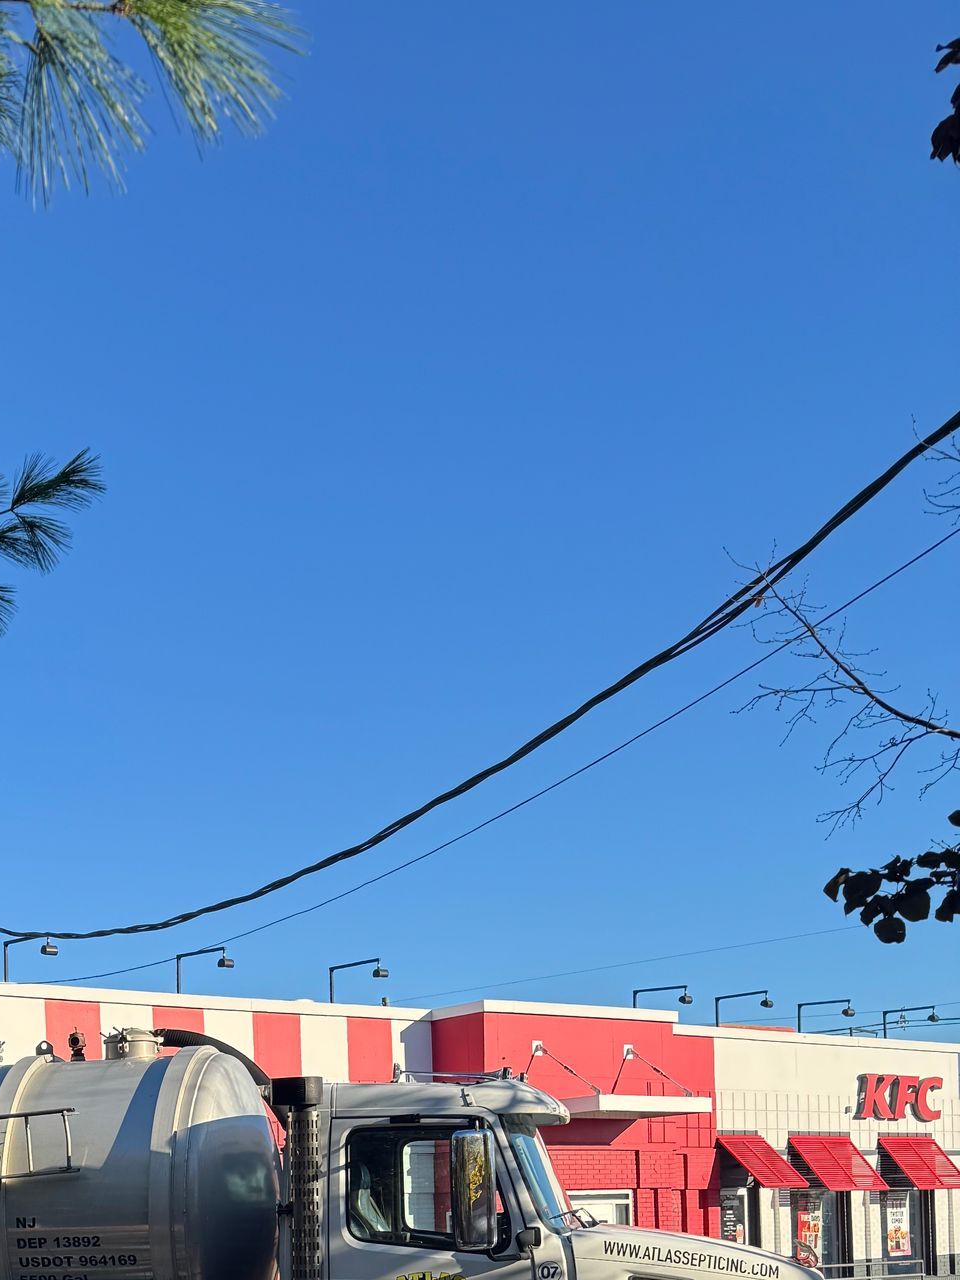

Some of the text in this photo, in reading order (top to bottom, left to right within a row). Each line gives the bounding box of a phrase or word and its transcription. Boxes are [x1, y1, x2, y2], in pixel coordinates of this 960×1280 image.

[854, 1073, 943, 1122] KFC
[16, 1217, 36, 1229] NJ
[16, 1236, 101, 1249] DEP 13892
[19, 1255, 137, 1268] USDOT 964169
[603, 1240, 780, 1279] WWW.ATLASSEPTICINC.COM
[541, 1266, 559, 1279] 07
